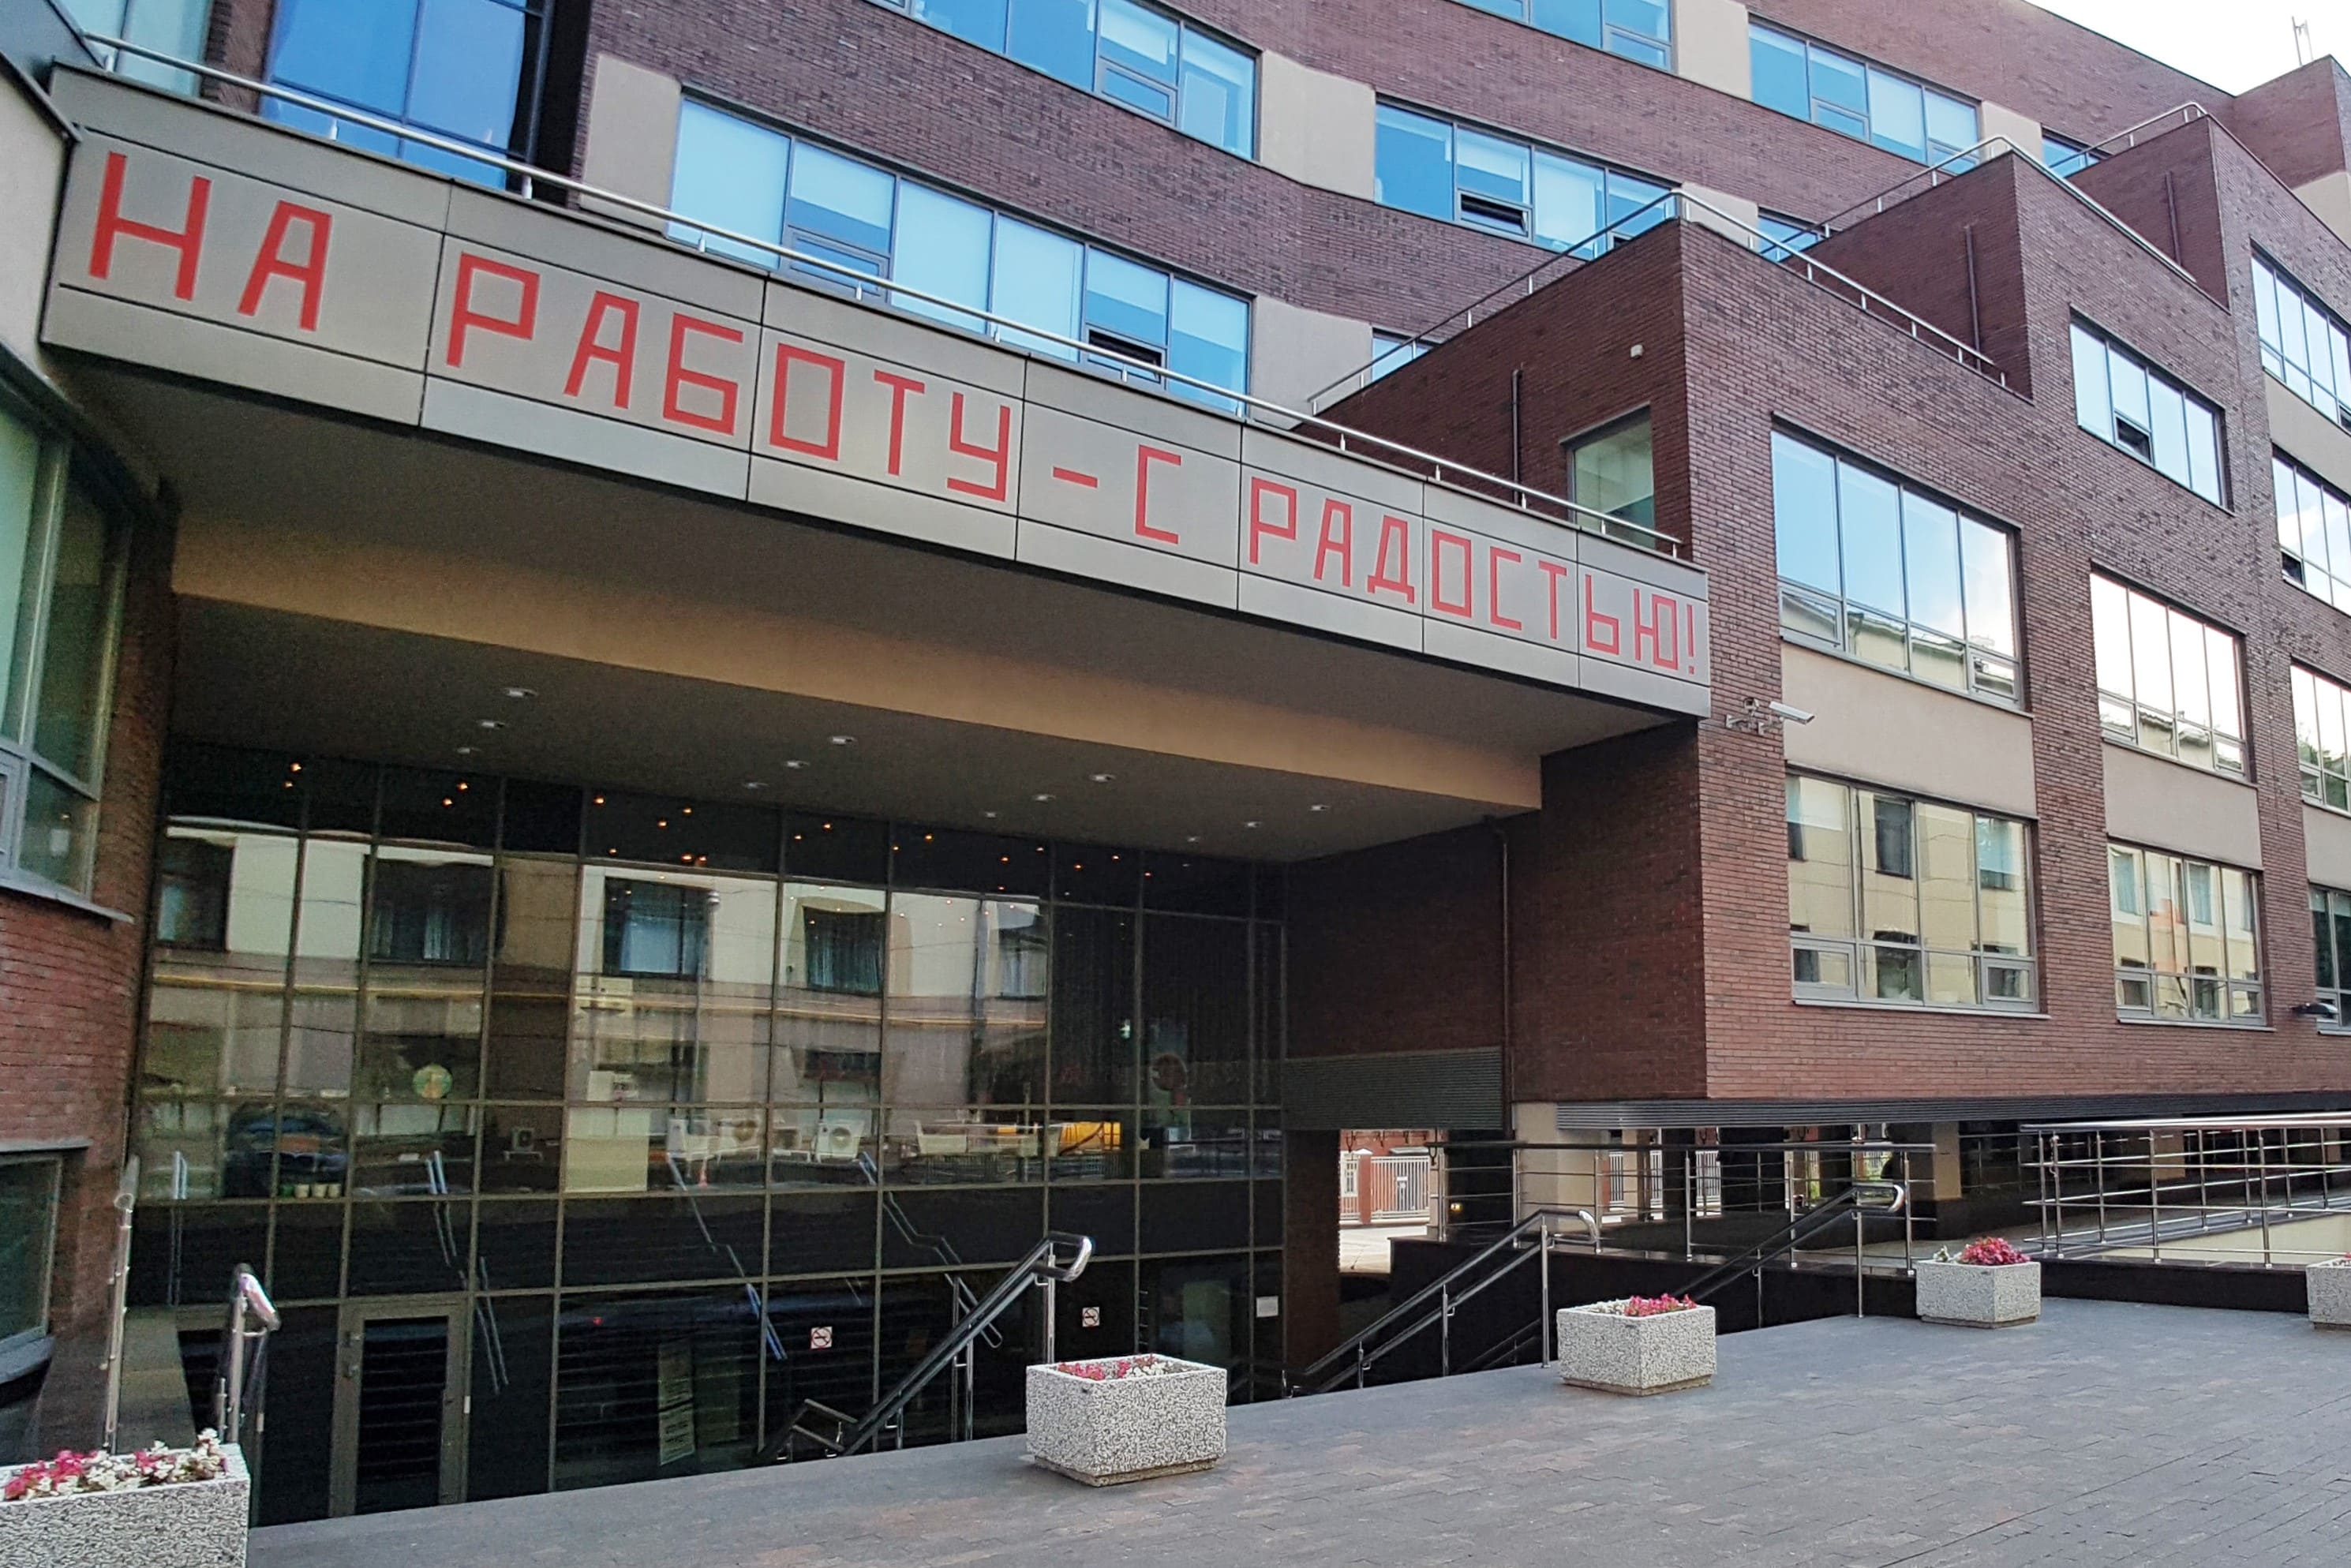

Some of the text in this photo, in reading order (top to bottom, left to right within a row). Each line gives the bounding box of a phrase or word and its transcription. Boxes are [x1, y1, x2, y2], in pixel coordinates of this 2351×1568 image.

[88, 152, 332, 331] НА
[445, 253, 1011, 503] РАБОТУ
[1135, 445, 1182, 544] С
[1249, 477, 1695, 675] РАДОСТЬЮ!
